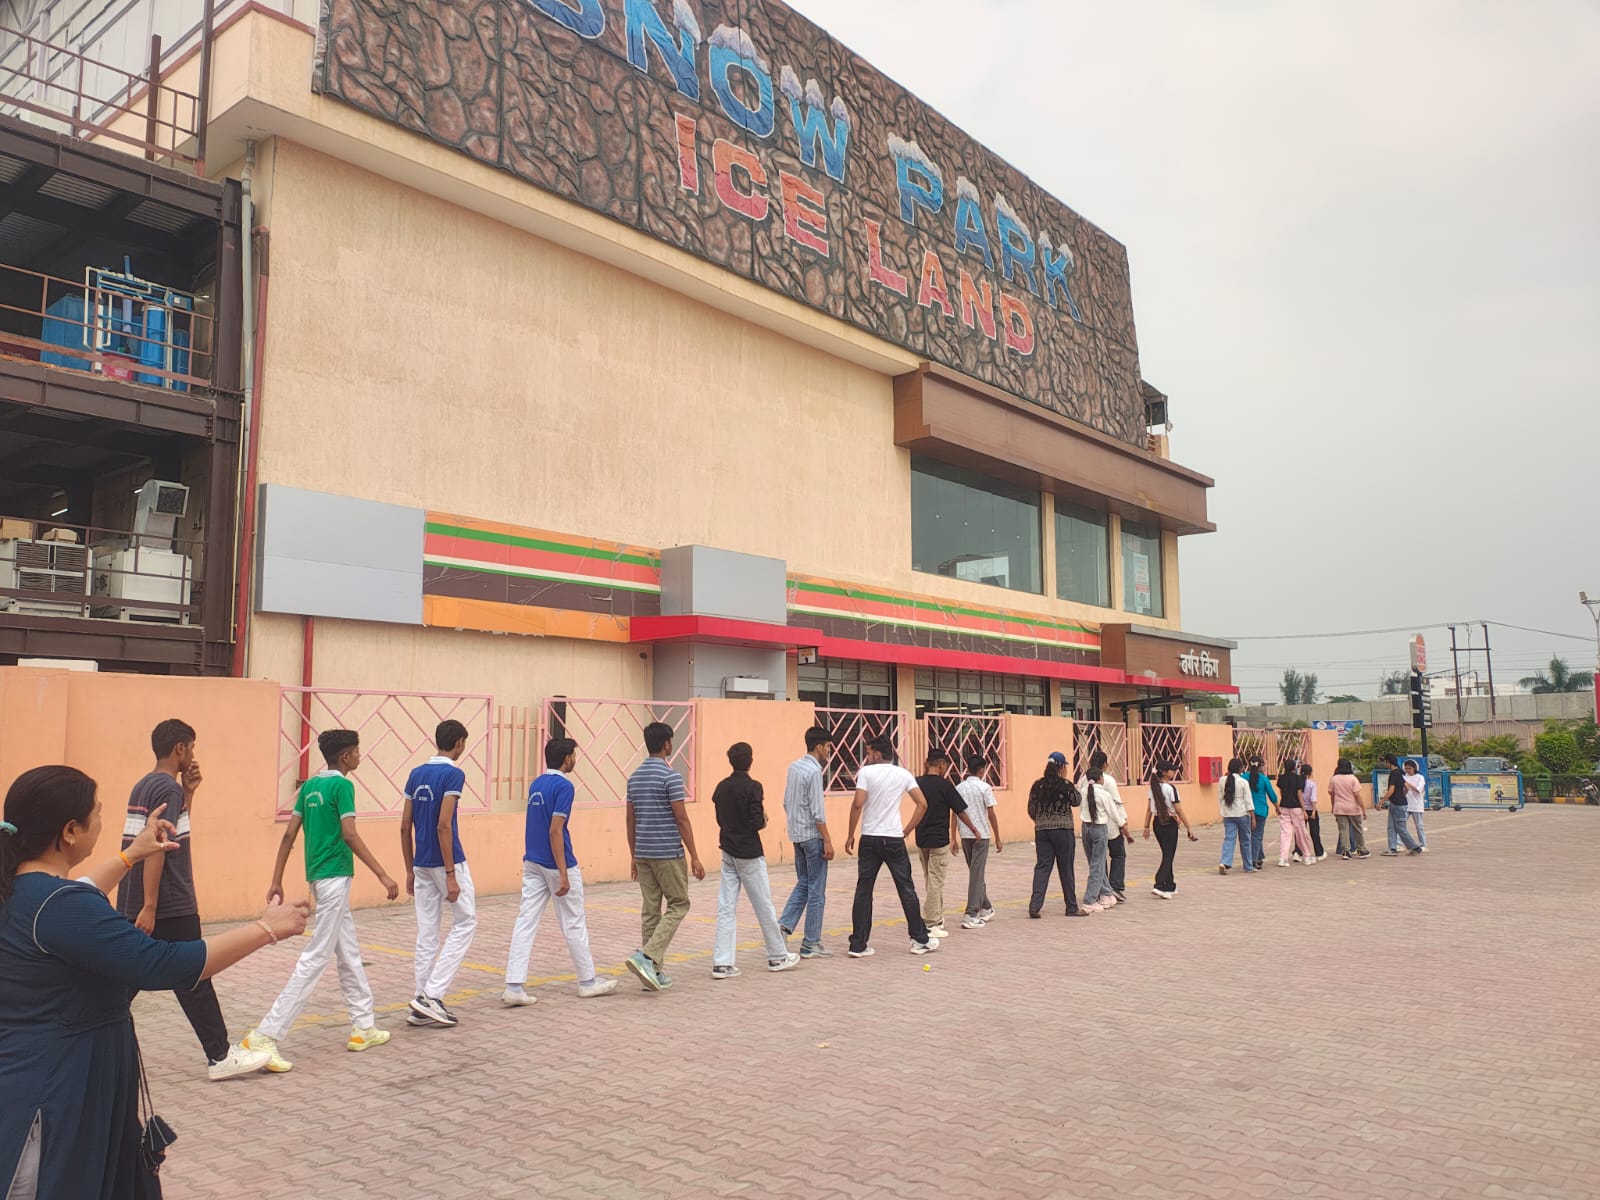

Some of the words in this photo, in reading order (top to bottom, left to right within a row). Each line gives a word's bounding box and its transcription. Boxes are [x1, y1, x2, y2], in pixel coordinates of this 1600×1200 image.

[674, 112, 830, 258] ICE
[863, 218, 1035, 356] LAND
[887, 132, 1081, 322] PARK
[1180, 647, 1199, 676] बर्गर
